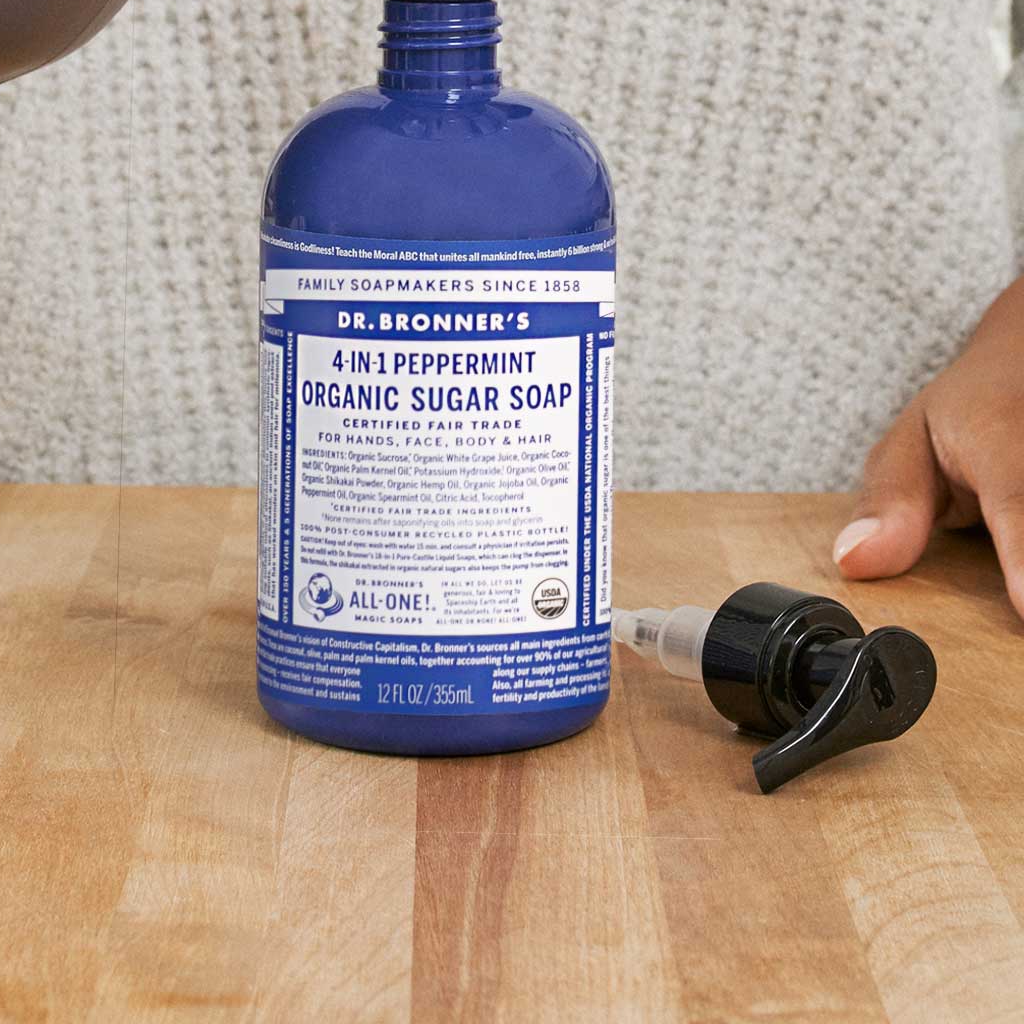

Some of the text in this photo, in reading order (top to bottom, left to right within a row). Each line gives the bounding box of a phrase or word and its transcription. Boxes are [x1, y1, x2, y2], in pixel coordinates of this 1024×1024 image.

[300, 242, 334, 256] Godliness!
[336, 247, 358, 258] Teach
[358, 249, 372, 259] the
[374, 250, 397, 260] Moral
[399, 252, 418, 260] ABC
[419, 252, 438, 262] that
[440, 252, 467, 262] unites
[468, 252, 480, 262] all
[481, 251, 517, 261] mankind
[537, 248, 566, 259] instantly
[298, 278, 580, 292] FAMILY SOAPMAKERS SINCE 1858
[338, 311, 530, 332] DR. BRONNER'S
[286, 332, 294, 394] EXCELLENCE
[332, 350, 536, 374] 4-IN-1 PEPPERMINT
[586, 333, 594, 382] PROGRAM
[302, 380, 572, 412] ORGANIC SUGAR SOAP
[585, 385, 593, 430] ORGANIC
[343, 418, 522, 430] CERTIFIED FAIR TRADE
[285, 428, 292, 440] OF
[318, 432, 340, 443] FOR
[456, 436, 496, 446] BODY
[502, 436, 510, 445] &
[518, 434, 552, 444] HAIR
[348, 450, 374, 462] Organic
[413, 454, 443, 464] Organic
[446, 454, 469, 462] White
[472, 454, 495, 464] Grape
[521, 452, 549, 462] Organic
[584, 434, 592, 483] NATIONAL
[324, 464, 350, 474] Organic
[352, 465, 369, 473] Palm
[371, 466, 396, 475] Kernel
[414, 467, 456, 476] Potassium
[506, 465, 536, 476] Organic
[284, 445, 292, 514] GENERATIONS
[387, 479, 418, 490] Organic
[421, 479, 444, 490] Hemp
[464, 480, 494, 490] Organic
[498, 478, 524, 489] Jojoba
[540, 476, 568, 486] Organic
[348, 491, 376, 502] Organic
[378, 492, 417, 502] Spearmint
[584, 485, 592, 513] USDA
[457, 506, 531, 514] INGREDIENTS
[584, 515, 592, 536] THE
[582, 575, 591, 627] CERTIFIED
[355, 614, 422, 624] MAGIC SOAPS
[328, 638, 373, 650] Constructive
[477, 643, 508, 652] sources
[510, 640, 519, 650] all
[522, 640, 540, 650] main
[542, 636, 580, 648] ingredients
[342, 652, 354, 662] and
[355, 654, 374, 664] palm
[375, 654, 398, 665] kernel
[420, 657, 454, 668] together
[456, 654, 502, 666] accounting
[504, 654, 514, 664] for
[516, 654, 532, 664] over
[554, 652, 561, 660] of
[330, 666, 360, 676] everyone
[492, 662, 578, 678] along our supply chains
[514, 679, 523, 688] all
[525, 678, 554, 689] farming
[555, 676, 568, 685] and
[378, 683, 390, 704] 12
[524, 692, 537, 701] and
